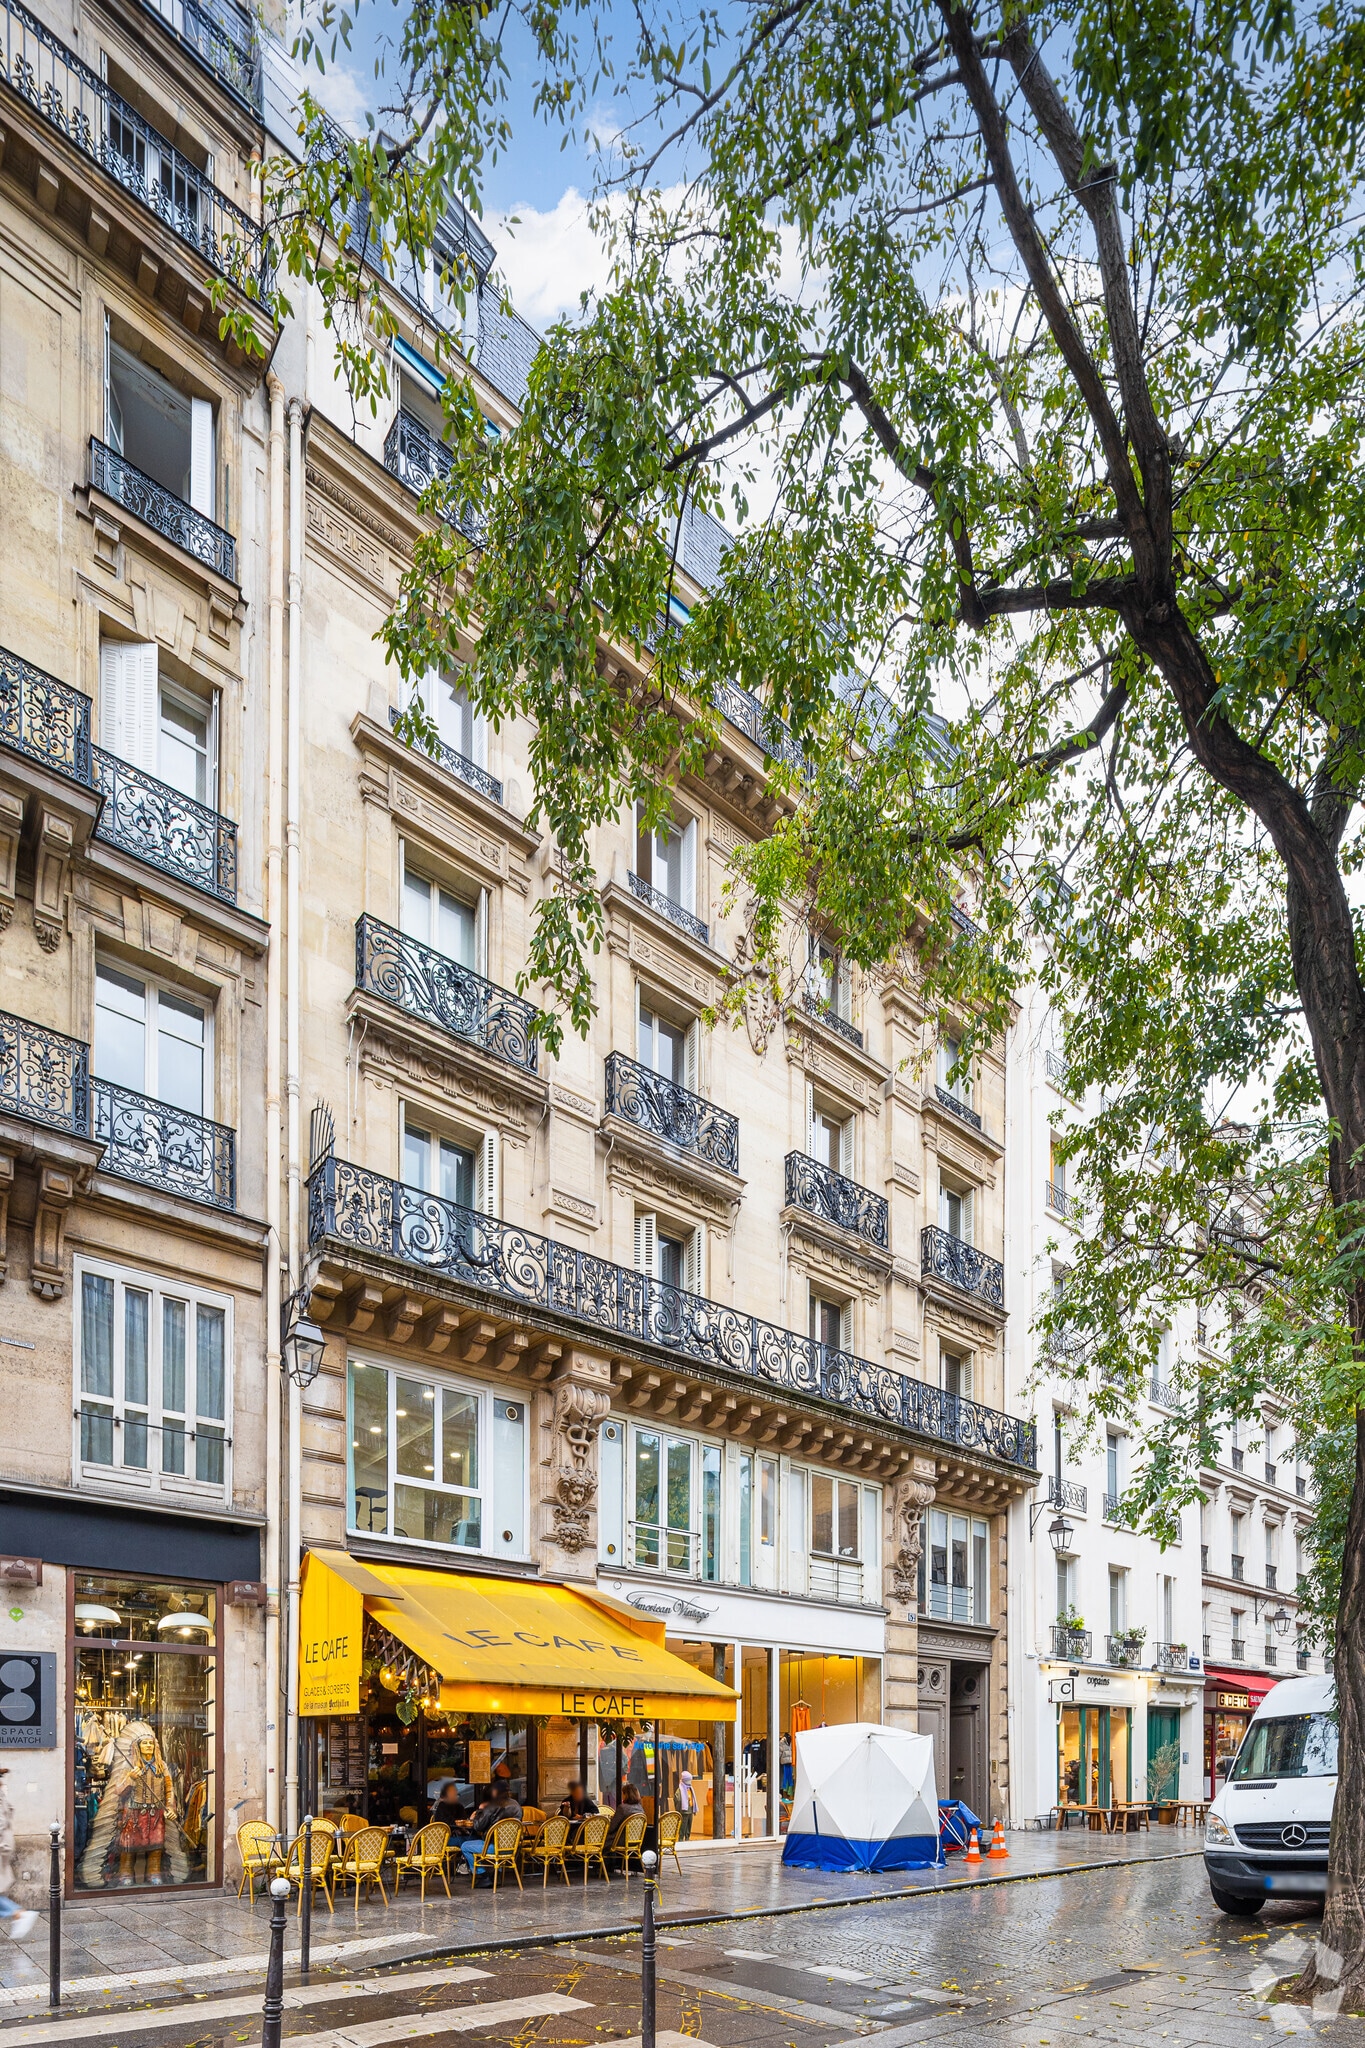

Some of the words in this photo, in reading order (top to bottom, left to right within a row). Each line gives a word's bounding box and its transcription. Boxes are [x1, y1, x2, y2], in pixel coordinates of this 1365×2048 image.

[672, 1597, 711, 1624] Vintage
[305, 1643, 319, 1664] LE
[321, 1636, 348, 1662] CAFE
[441, 1629, 512, 1649] LE
[513, 1631, 644, 1663] CAFE
[1060, 1683, 1071, 1695] C
[1086, 1675, 1110, 1688] copains
[561, 1693, 586, 1713] LE
[593, 1695, 645, 1716] CAFE
[1, 1727, 42, 1736] SPACE
[671, 1741, 706, 1754] sauvage
